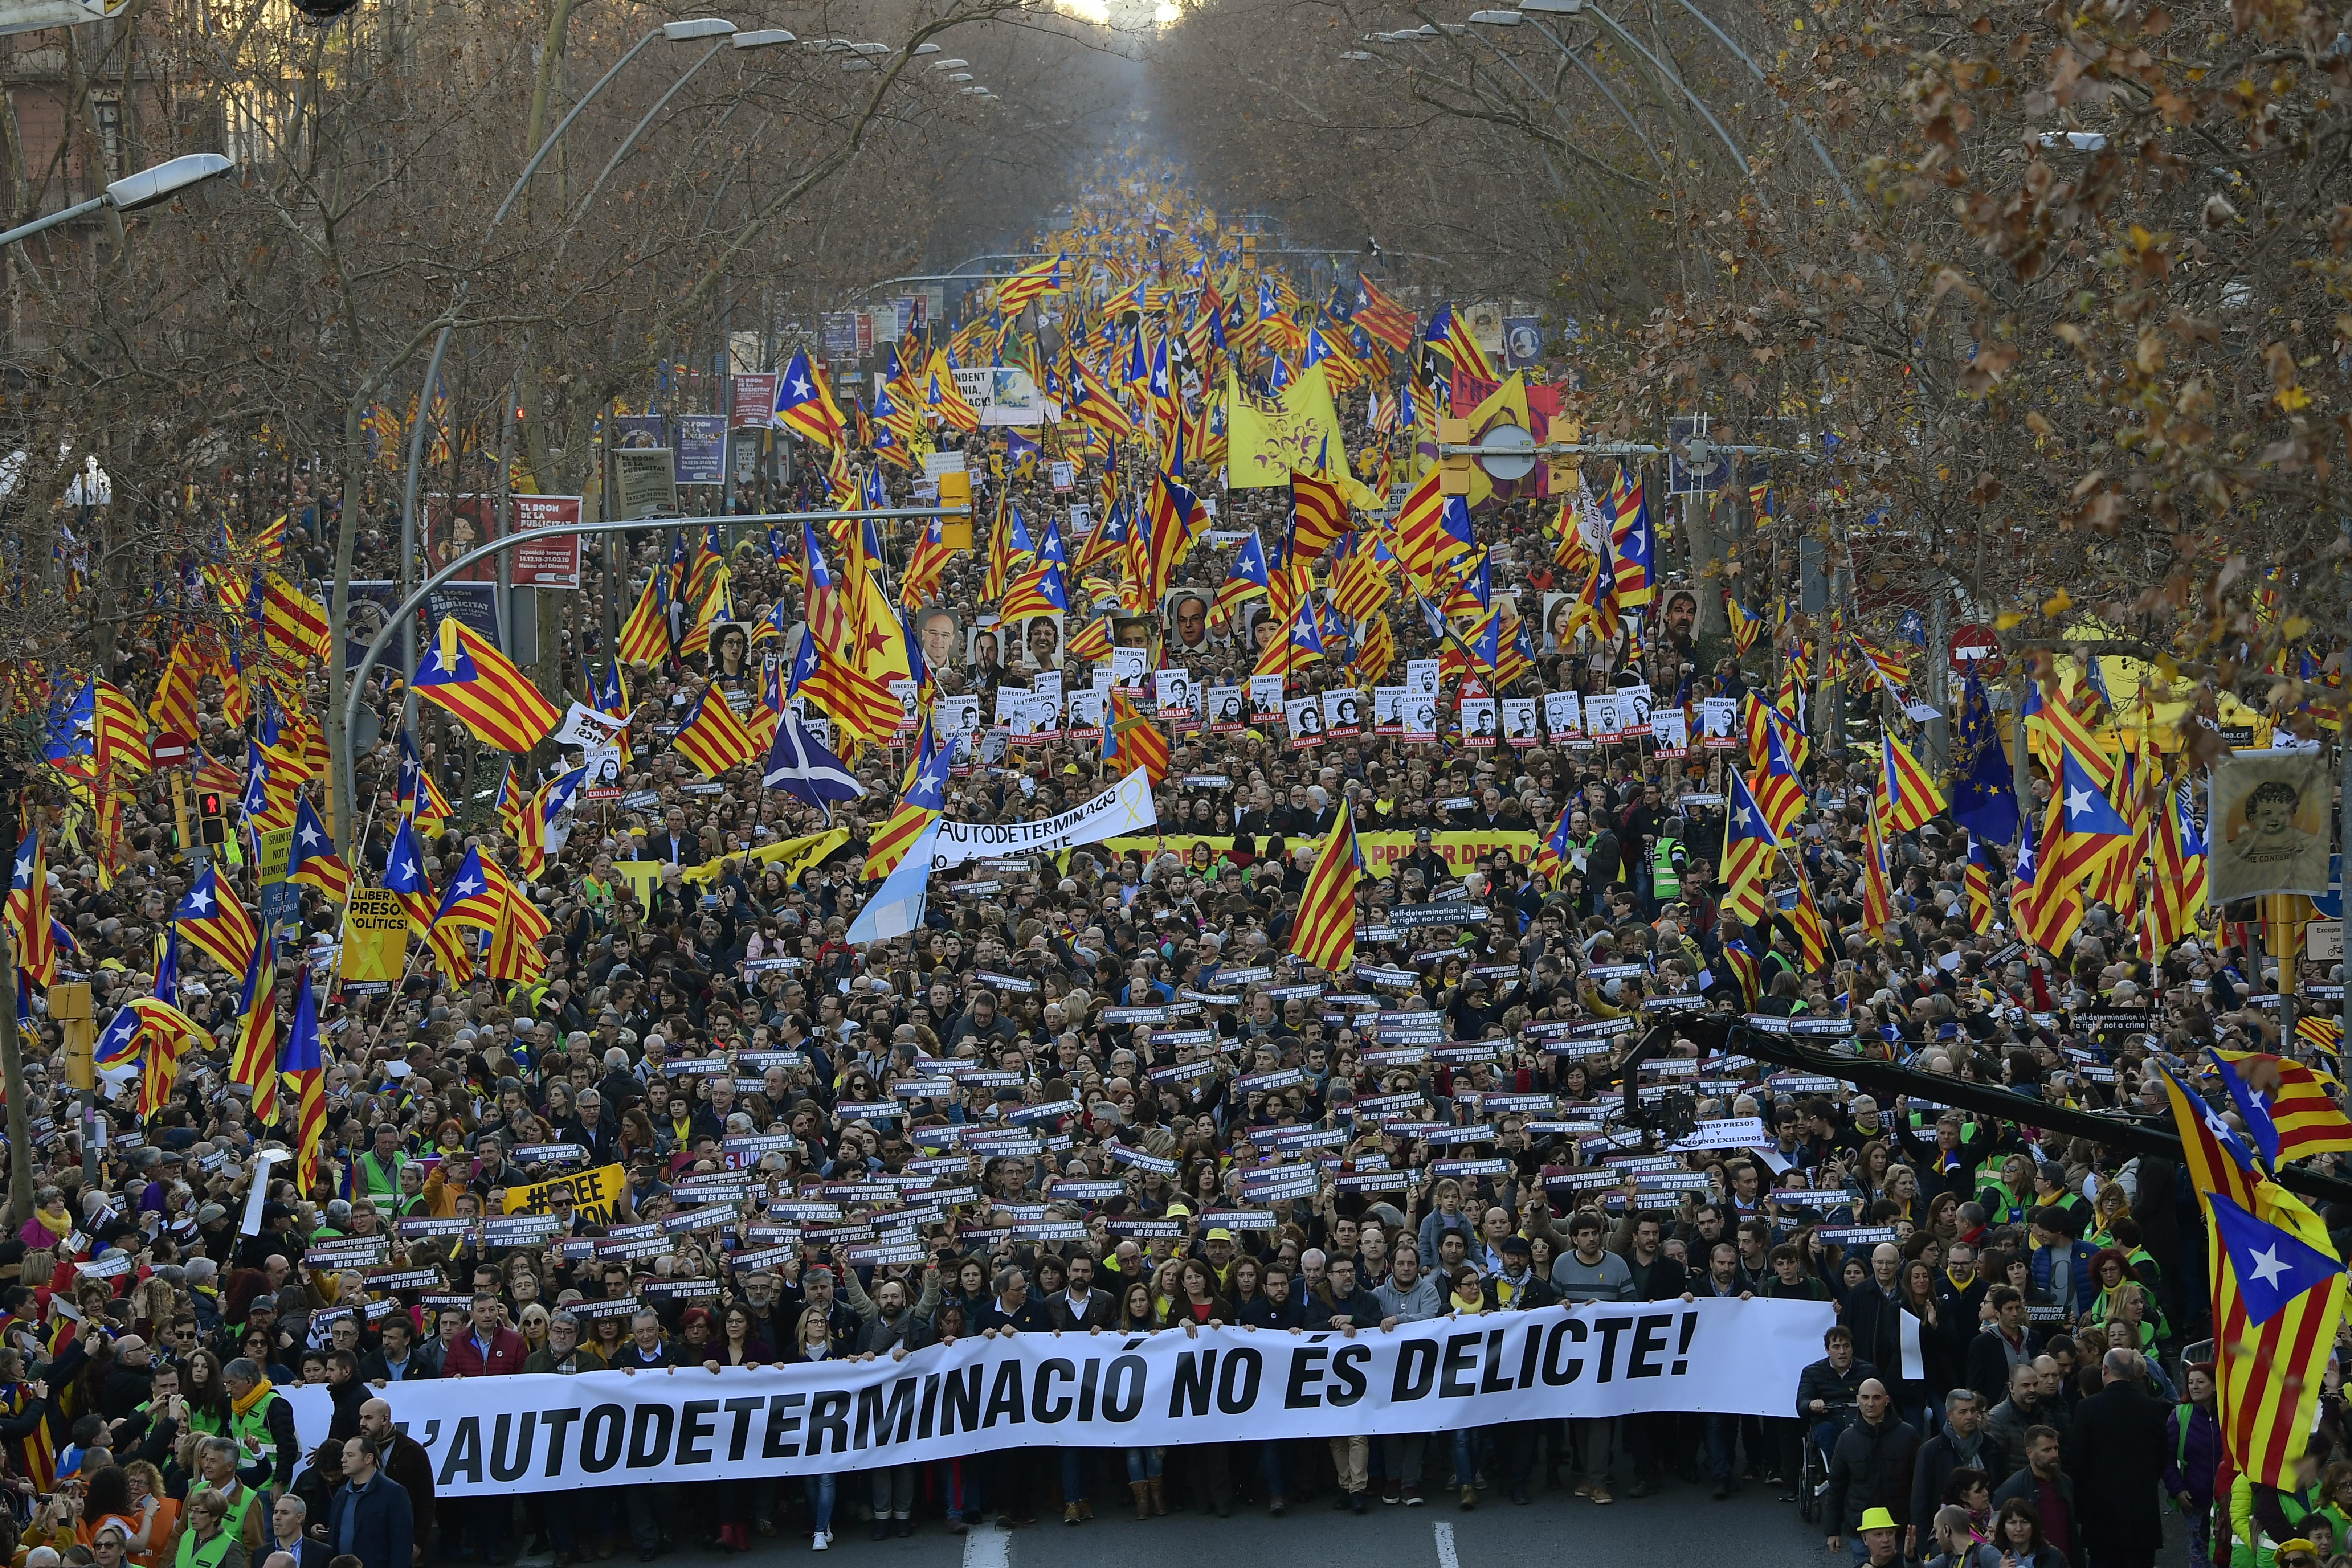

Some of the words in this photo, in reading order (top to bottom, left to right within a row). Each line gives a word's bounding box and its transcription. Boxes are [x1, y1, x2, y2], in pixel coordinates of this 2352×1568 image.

[1390, 495, 1402, 504] EU
[533, 504, 559, 512] BOOM
[432, 601, 489, 611] PUBLICITAT
[1036, 674, 1059, 683] FREEDOM
[1618, 689, 1648, 697] LLIBERTAT
[1025, 695, 1055, 704] FREEDOM
[1546, 694, 1577, 703] LLIBERTAT
[1286, 700, 1315, 710] LLIBERTAT
[1159, 709, 1189, 717] EXILIAT
[1073, 729, 1103, 737] EXILIAT
[1293, 737, 1321, 746] EXILIADA
[1655, 749, 1686, 758] EXILED
[936, 788, 1116, 844] AUTODETERMINACIÓ
[269, 833, 286, 845] SPAIN
[286, 831, 292, 841] IS
[273, 848, 285, 860] NOT
[286, 847, 290, 857] A
[1462, 844, 1513, 865] DELS
[262, 863, 287, 877] DEMOCR
[350, 901, 404, 916] PRESO
[1390, 907, 1460, 917] Self-determination
[1399, 916, 1419, 925] right,
[1105, 1007, 1161, 1017] L'AUTODETERMINACIÓ
[1380, 1010, 1438, 1021] L'AUTODETERMINACIÓ
[2074, 1013, 2137, 1021] Self-determination
[1790, 1018, 1849, 1027] L'AUTODETERMINACIÓ
[740, 1051, 797, 1060] L'AUTODETERMINACIÓ
[959, 1071, 1021, 1081] L'AUTODETERMINACIÓ
[1485, 1094, 1549, 1105] L'AUTODETERMINACIÓ
[838, 1100, 898, 1112] L'AUTODETERMINACIÓ
[1528, 1102, 1553, 1110] DELICTE
[516, 1143, 577, 1154] L'AUTODETERMINACIÓ
[1335, 1172, 1404, 1185] L'AUTODETERMINACIÓ
[1546, 1169, 1616, 1184] L'AUTODETERMINACIÓ
[1371, 1182, 1380, 1190] ÉS
[1381, 1181, 1408, 1189] DELICTE
[1584, 1179, 1592, 1188] ÉS
[1593, 1178, 1620, 1187] DELICTE
[772, 1203, 838, 1211] L'AUTODETERMINACIÓ
[807, 1211, 815, 1219] ÉS
[1144, 1228, 1153, 1236] ÉS
[1821, 1226, 1891, 1237] L'AUTODETERMINACIÓ
[309, 1249, 375, 1261] L'AUTODETERMINACIÓ
[344, 1258, 352, 1266] ÉS
[645, 1279, 716, 1290] L'AUTODETERMINACIÓ
[683, 1288, 691, 1296] ÉS
[394, 1340, 1148, 1484] 'AUTODETERMINACIÓ
[1169, 1348, 1263, 1418] NO
[1284, 1334, 1367, 1407] ÉS
[1391, 1312, 1697, 1402] DELICTE!
